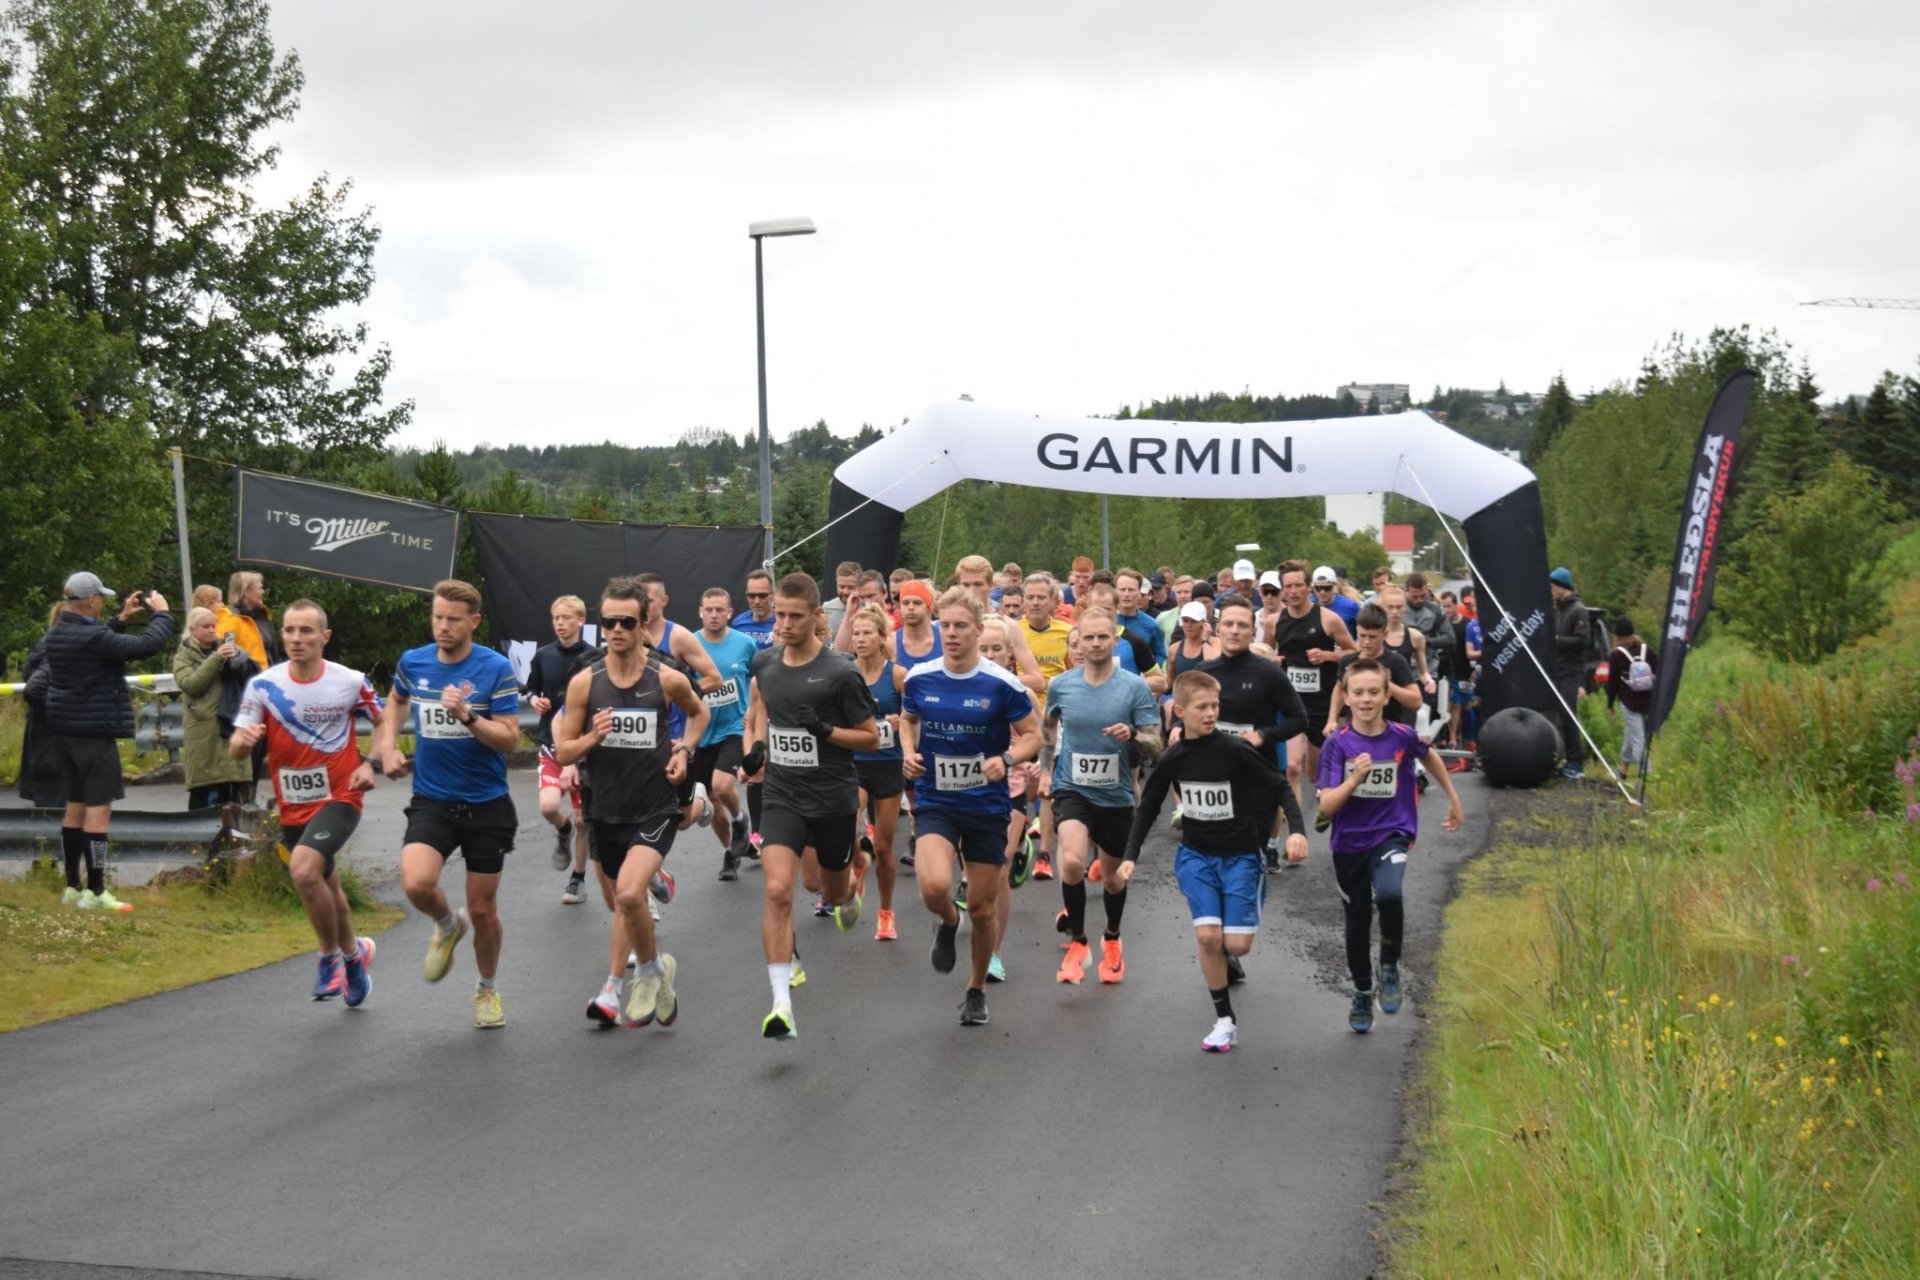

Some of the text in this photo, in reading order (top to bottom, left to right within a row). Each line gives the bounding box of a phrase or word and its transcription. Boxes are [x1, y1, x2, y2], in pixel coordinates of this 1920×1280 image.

[1037, 432, 1293, 475] GARMIN
[266, 509, 434, 551] IT'S Miller TIME
[1290, 671, 1318, 684] 1592
[424, 707, 458, 726] 158
[612, 715, 647, 734] 990
[924, 721, 987, 734] ICELANDIC
[620, 738, 653, 747] Timataka
[771, 733, 814, 753] 1556
[938, 761, 982, 778] 1174
[1079, 758, 1110, 774] 977
[282, 772, 326, 791] 1093
[1184, 789, 1228, 807] 1100
